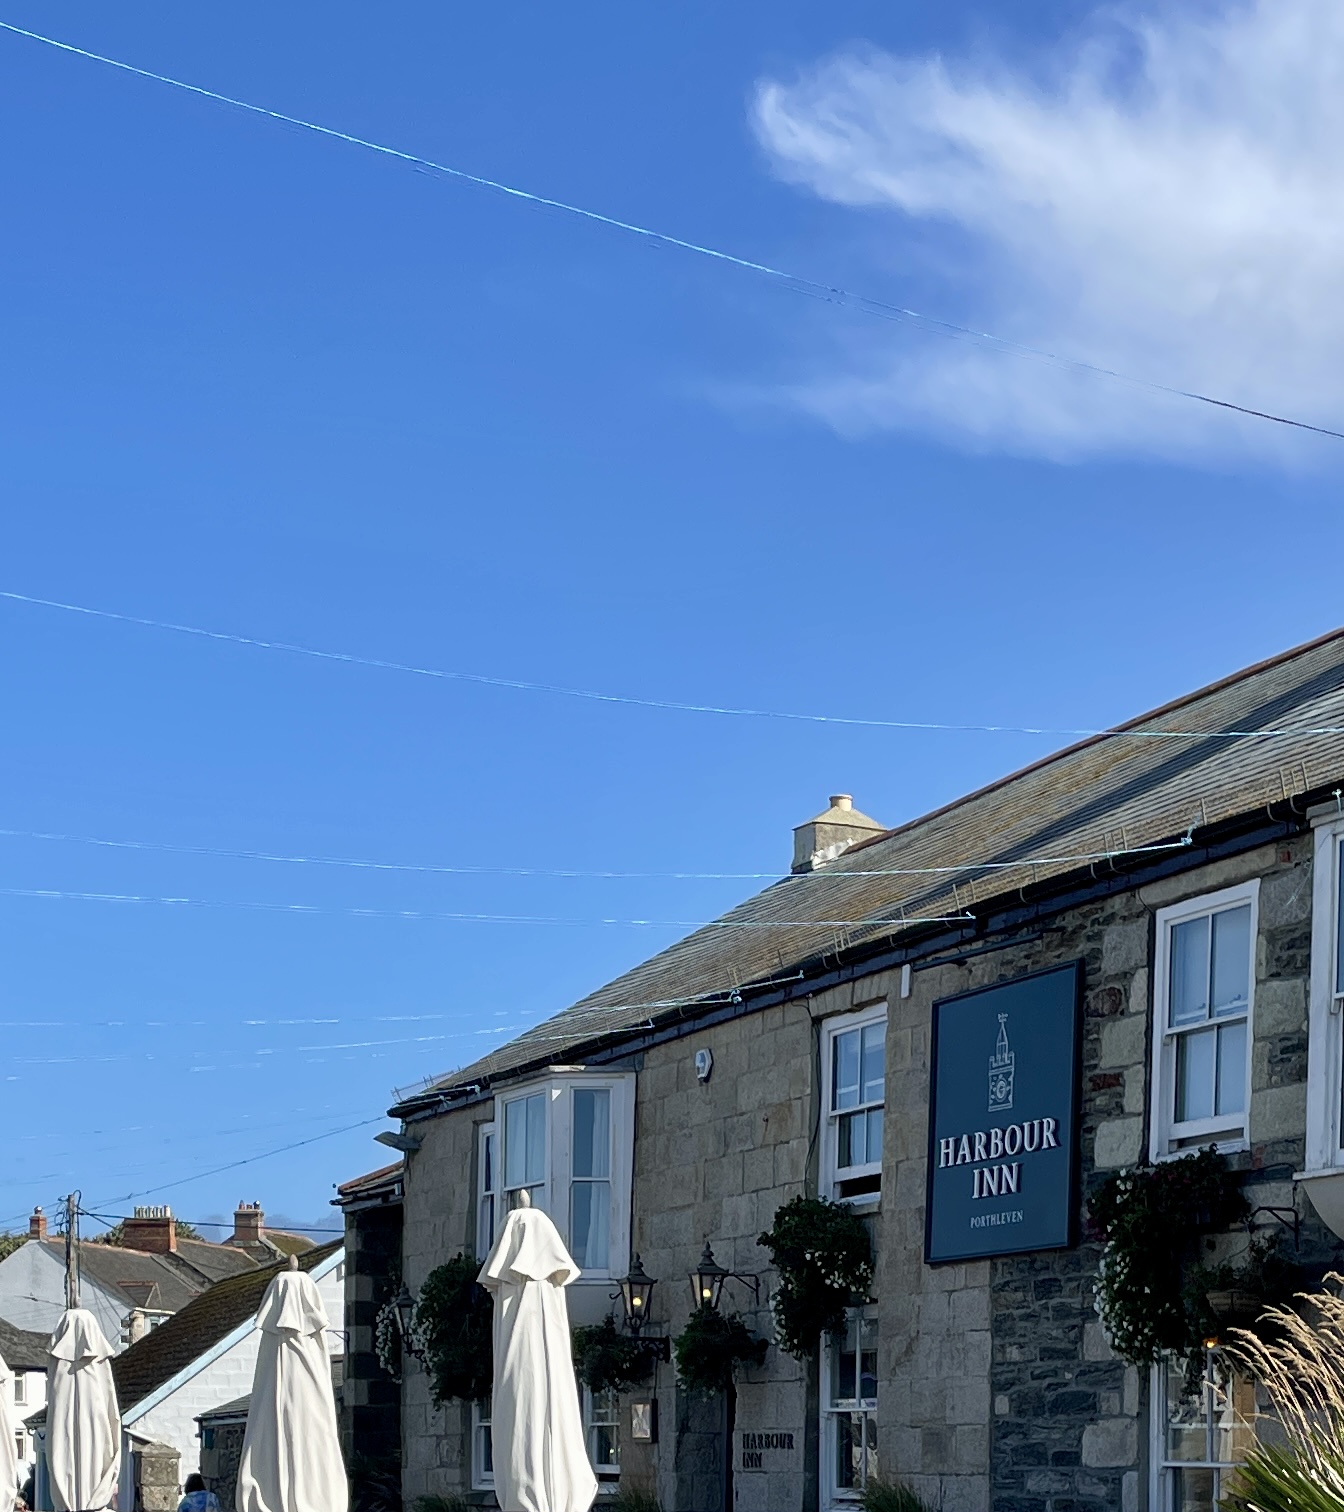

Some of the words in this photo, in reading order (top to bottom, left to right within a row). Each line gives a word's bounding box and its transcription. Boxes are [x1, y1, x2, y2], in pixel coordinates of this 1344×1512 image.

[939, 1118, 1057, 1168] HARBOUR
[972, 1162, 1020, 1199] INN
[970, 1210, 1024, 1229] PORTHLEVEN
[743, 1433, 794, 1450] HARBOUR
[742, 1452, 762, 1469] INN
